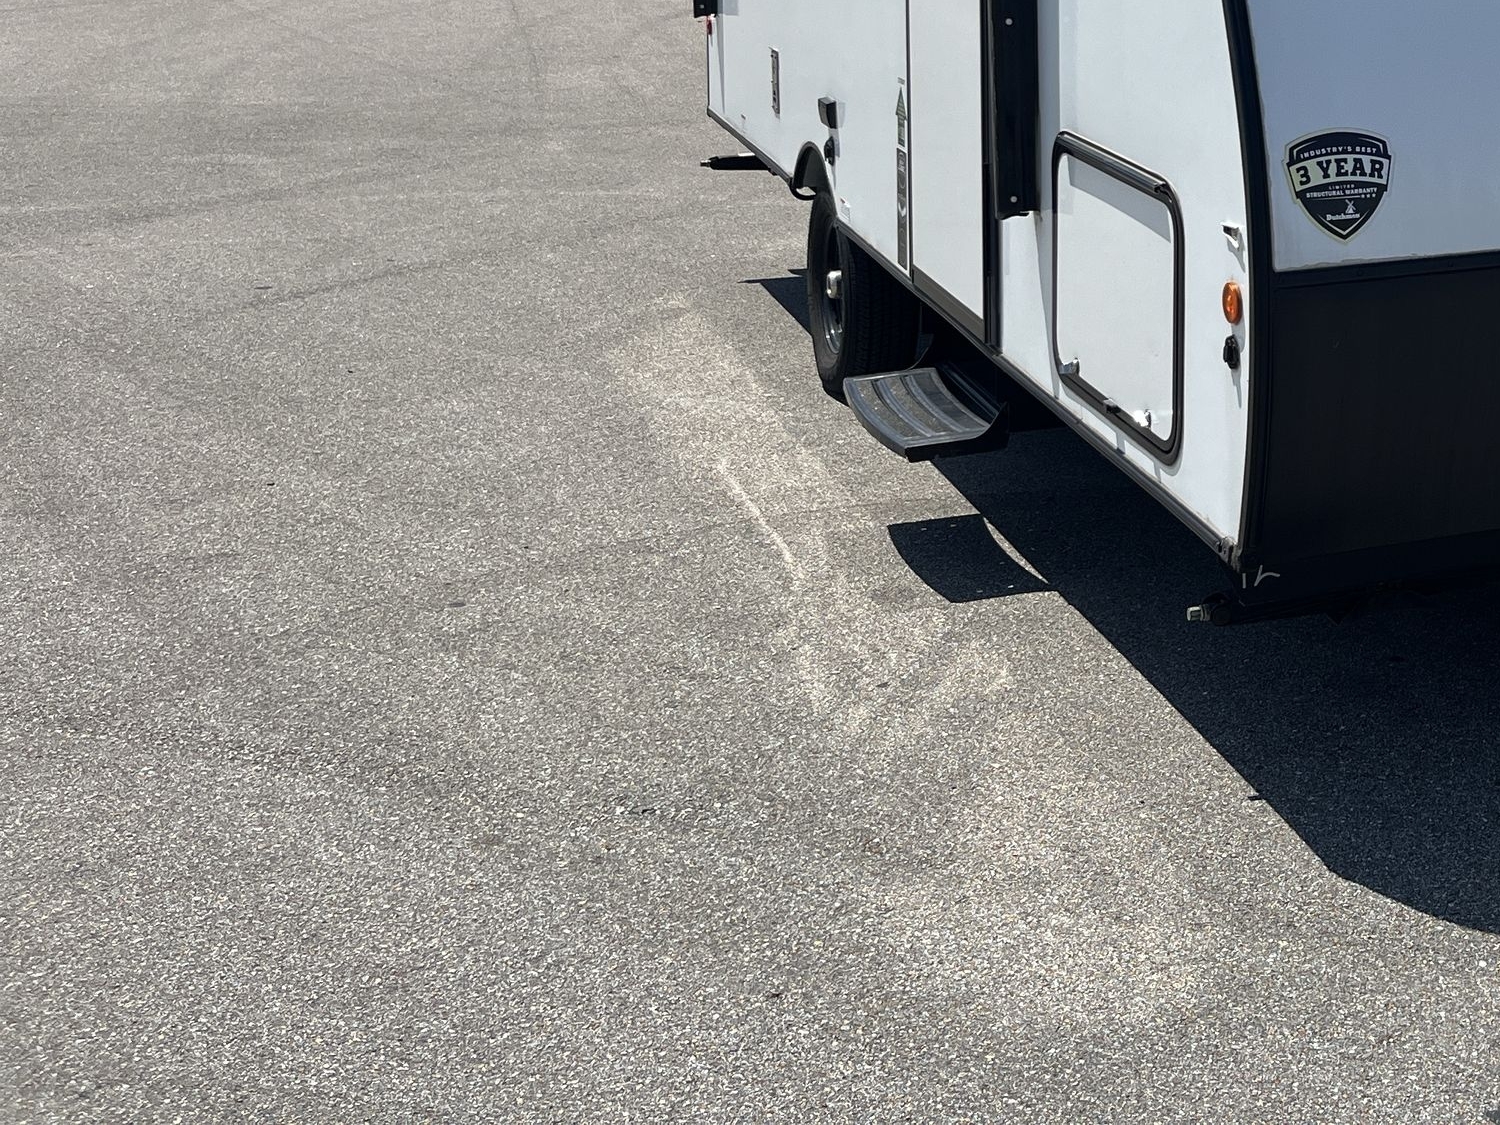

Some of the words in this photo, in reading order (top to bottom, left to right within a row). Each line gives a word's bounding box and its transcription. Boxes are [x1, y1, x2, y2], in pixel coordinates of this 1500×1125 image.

[1300, 146, 1352, 158] INDUSTRY'S
[1355, 146, 1377, 154] BEST
[1295, 165, 1311, 186] 3
[1316, 157, 1384, 180] YEAR
[1305, 190, 1345, 198] STRUCTURAL
[1345, 187, 1378, 196] WARRANTY
